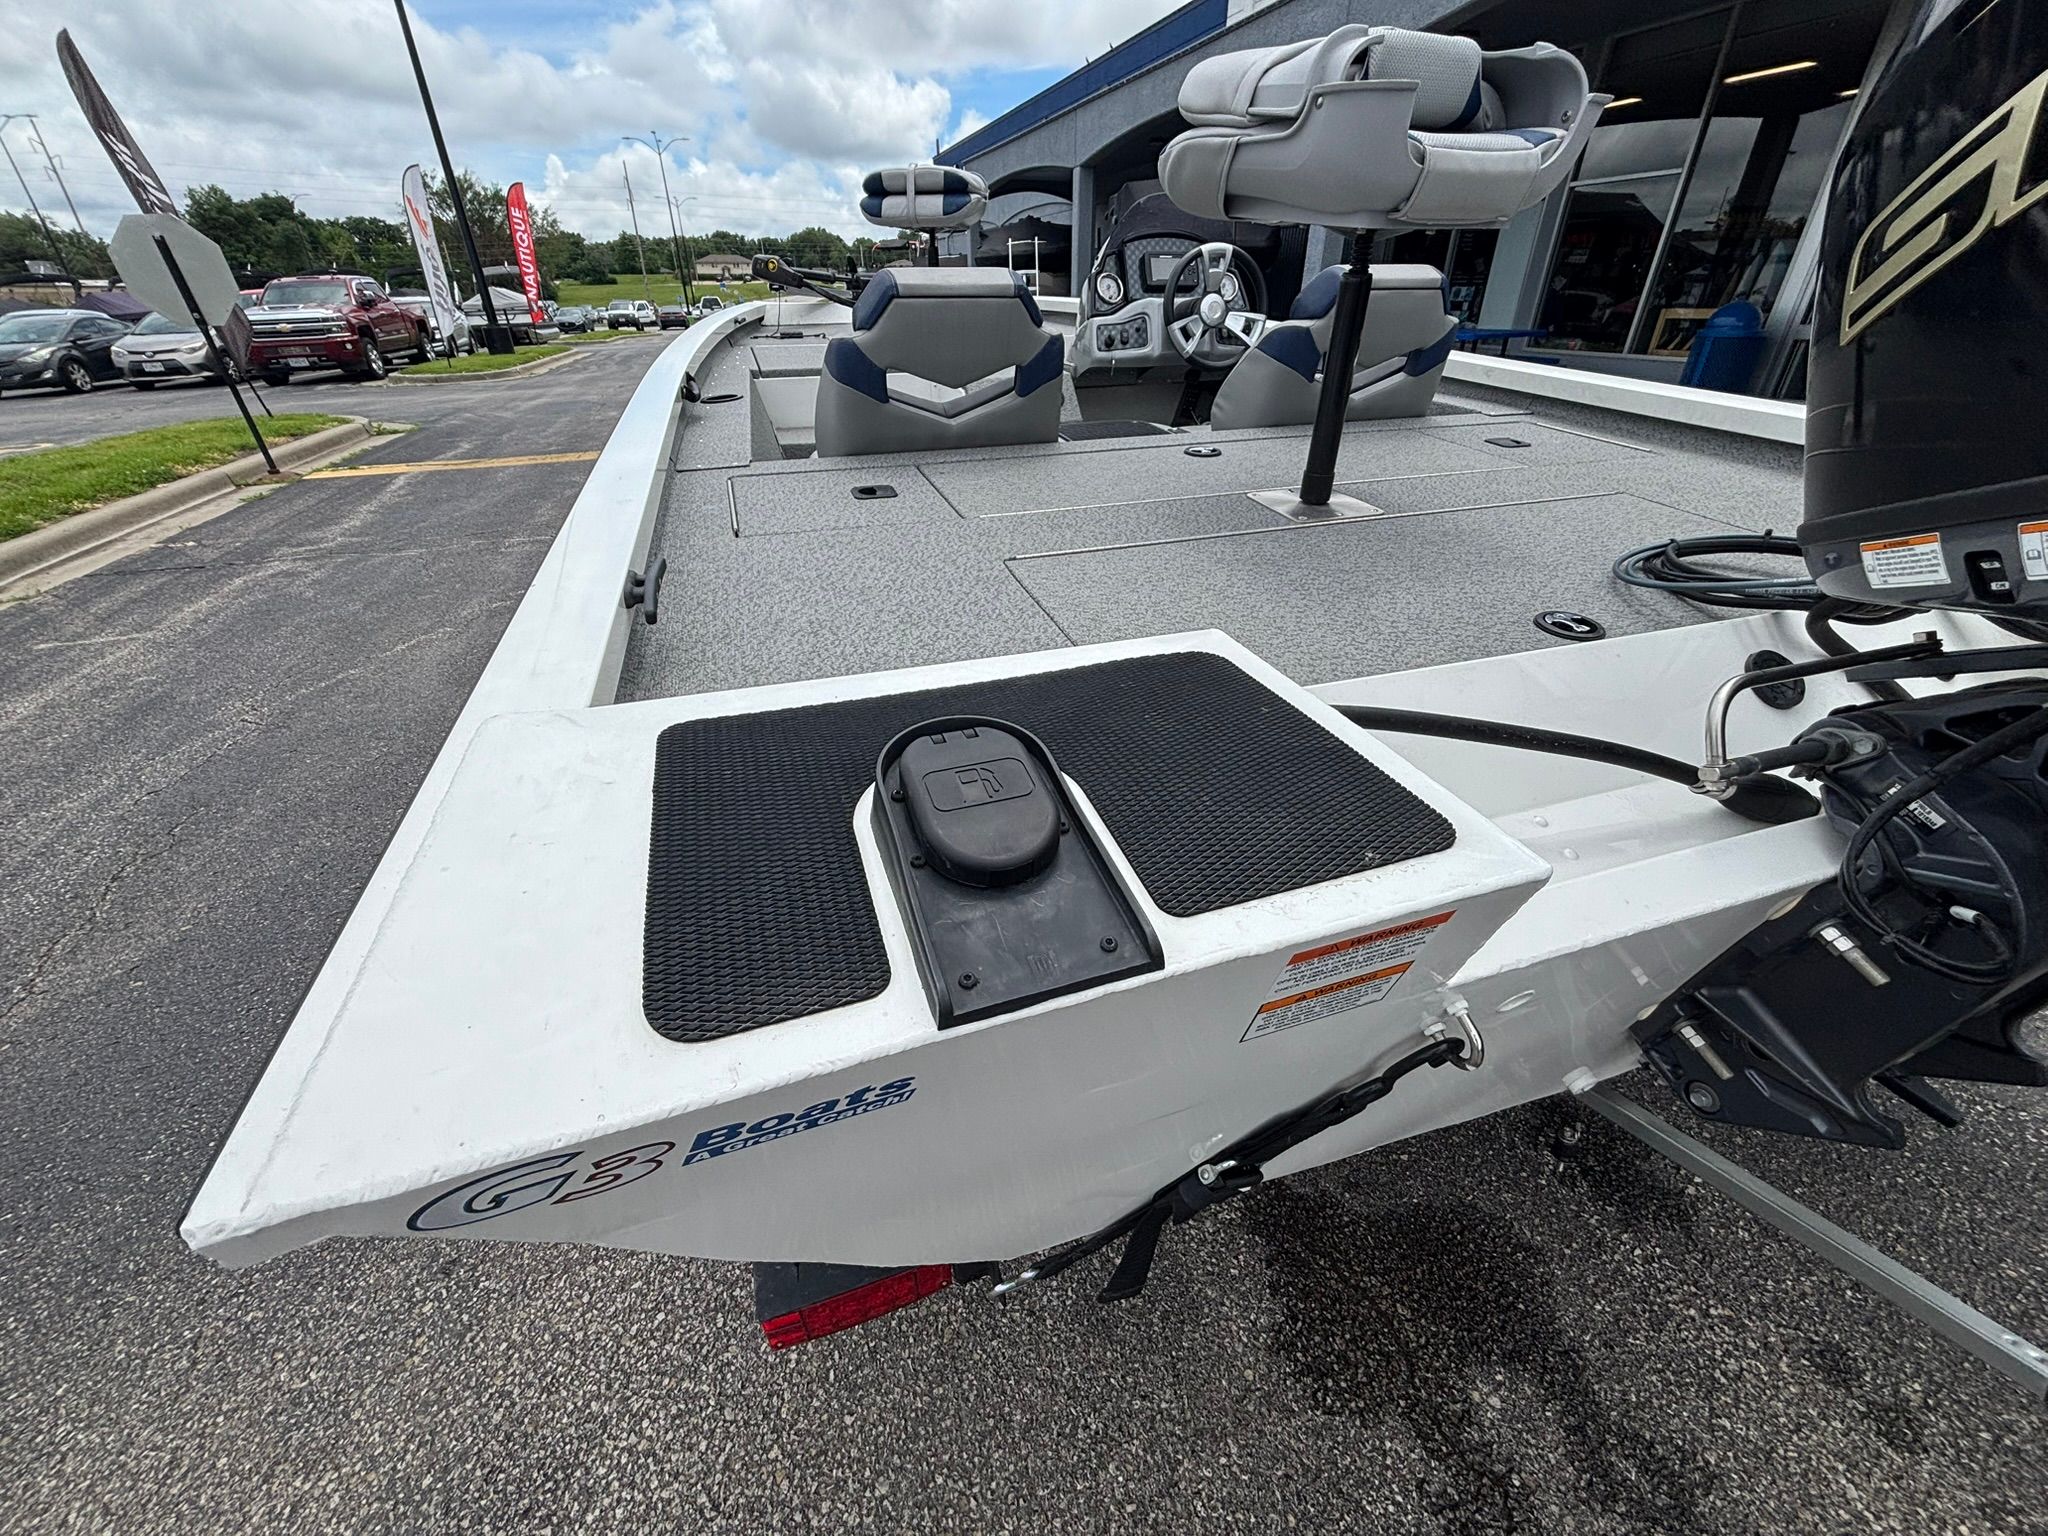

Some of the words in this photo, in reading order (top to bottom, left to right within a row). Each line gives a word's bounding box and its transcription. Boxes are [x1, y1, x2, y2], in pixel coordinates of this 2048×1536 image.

[511, 206, 538, 299] NAUTIQUE
[1350, 920, 1425, 947] WARNING
[1314, 973, 1380, 996] WARNING
[688, 1153, 710, 1165] A
[722, 1121, 809, 1152] Great
[816, 1089, 913, 1125] Catch!
[689, 1076, 916, 1153] Boats
[406, 1140, 676, 1232] G3
